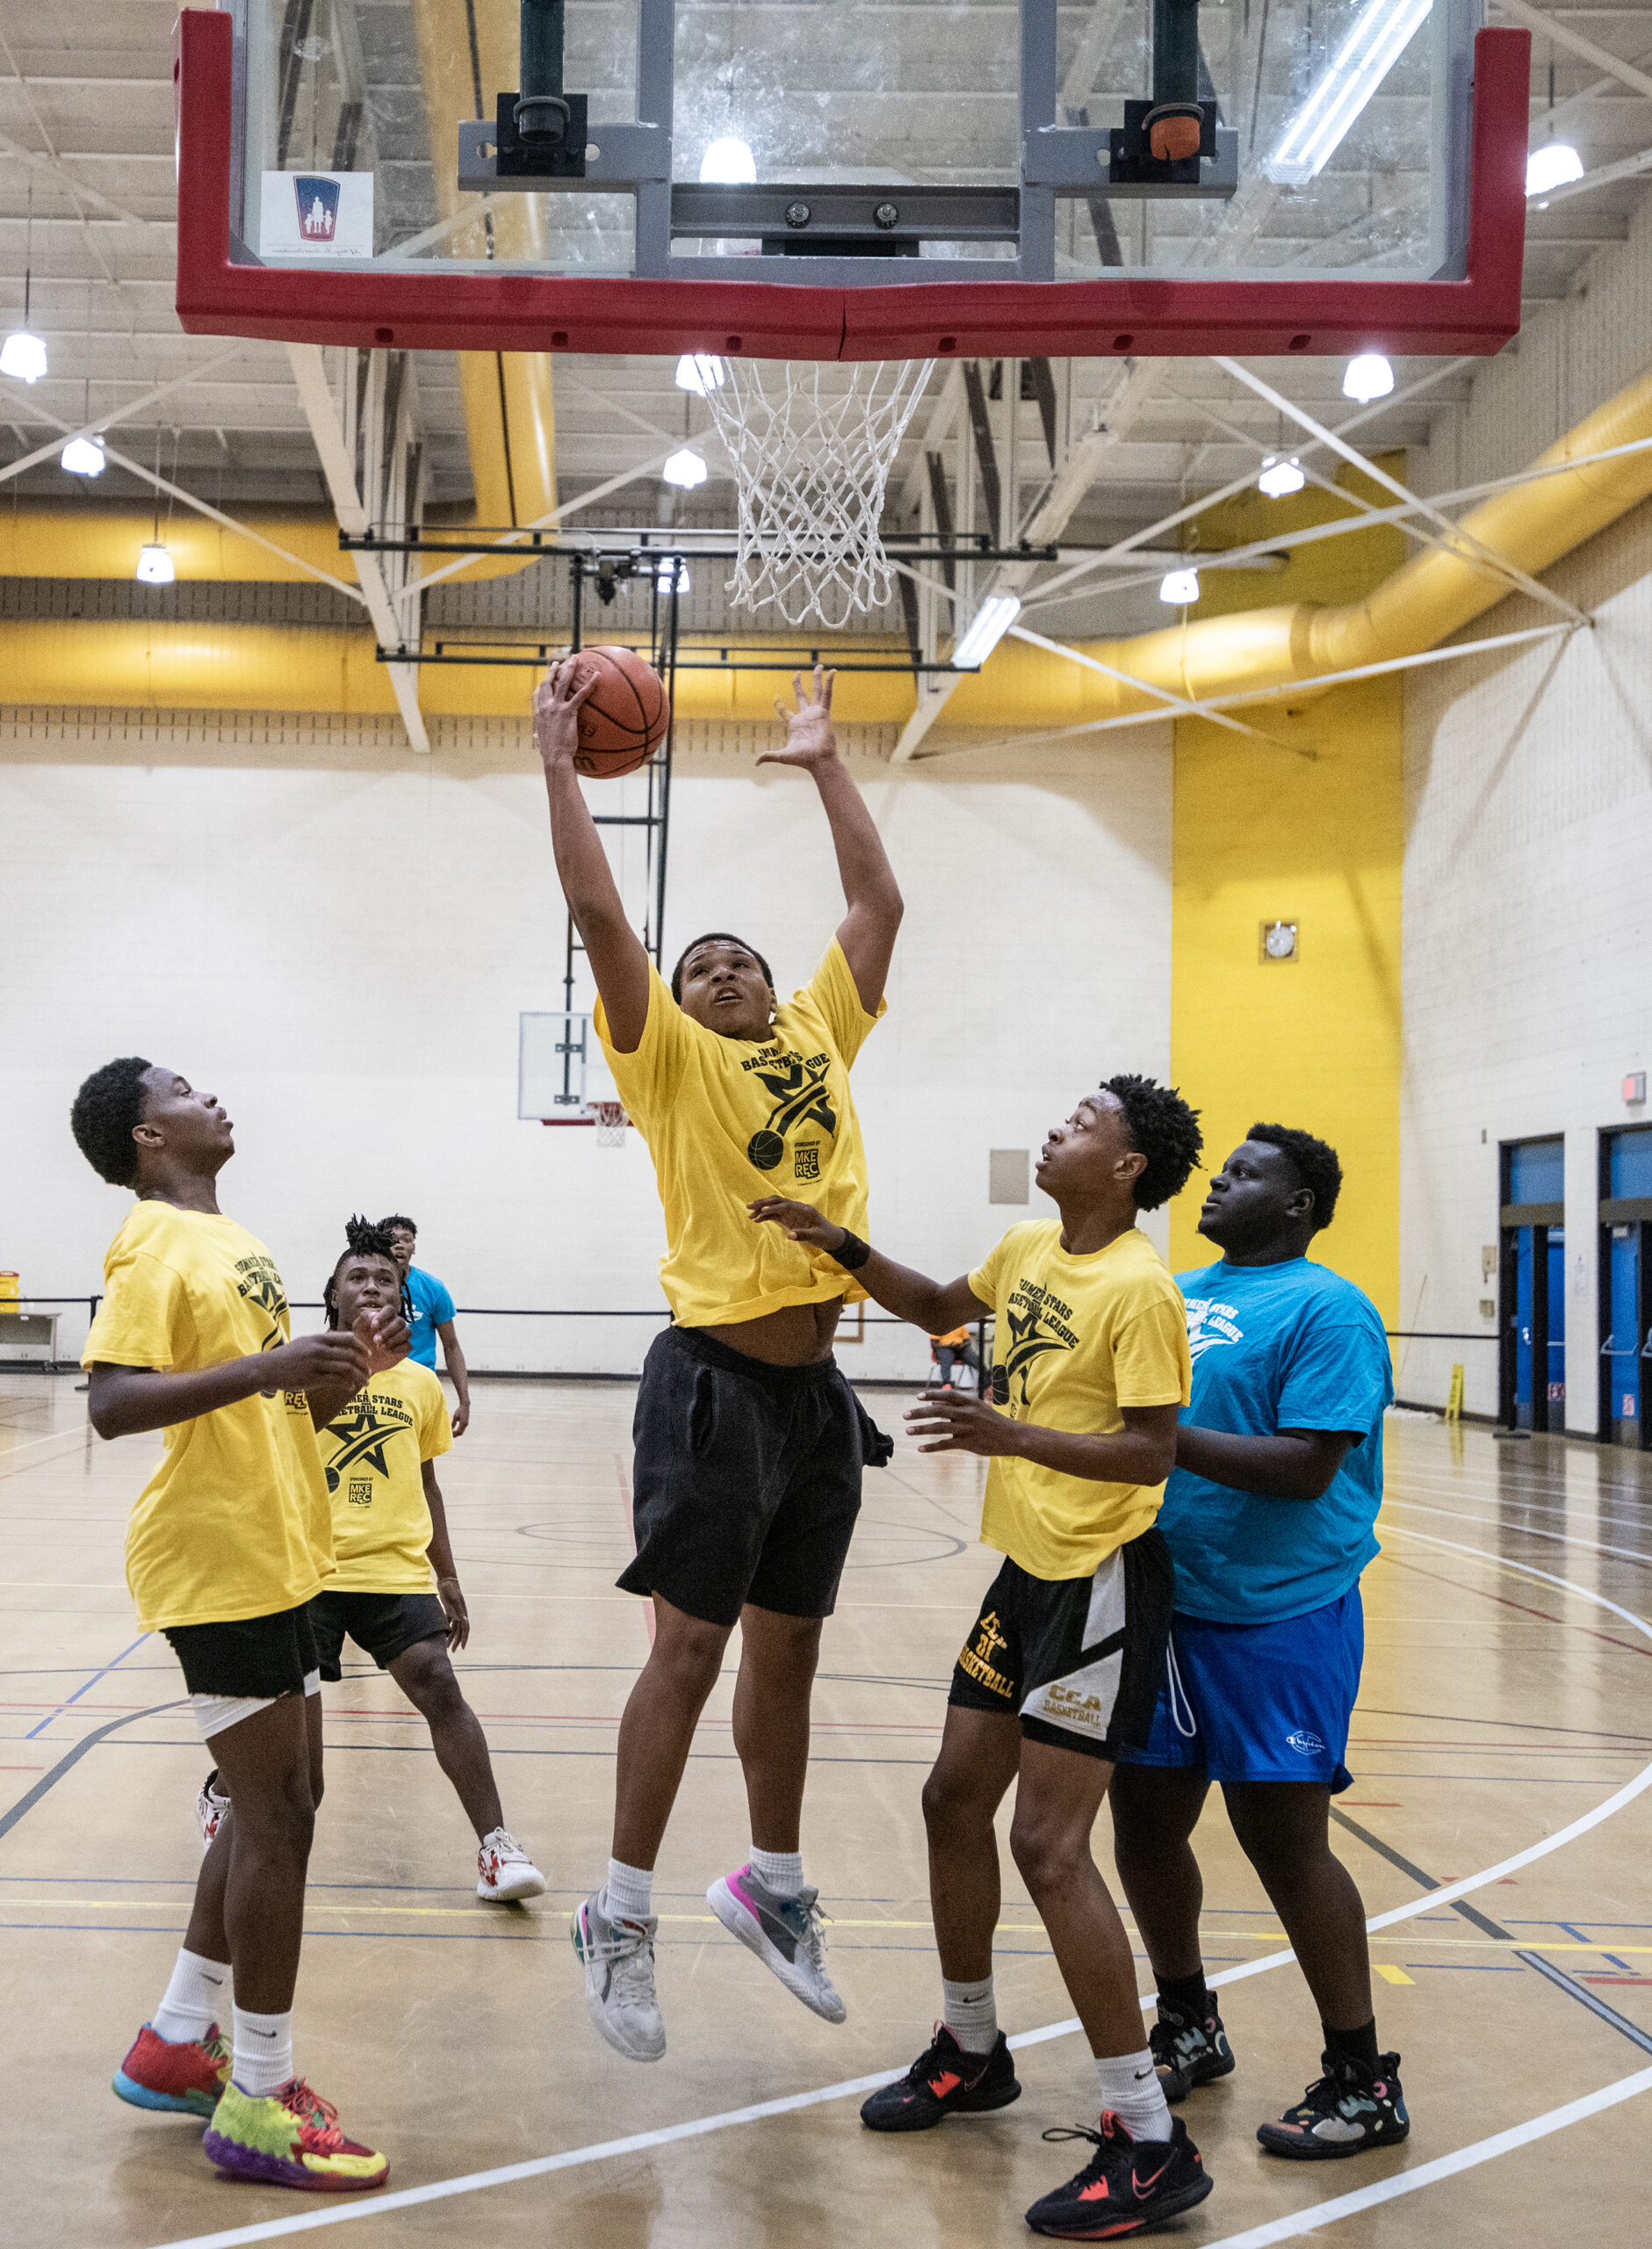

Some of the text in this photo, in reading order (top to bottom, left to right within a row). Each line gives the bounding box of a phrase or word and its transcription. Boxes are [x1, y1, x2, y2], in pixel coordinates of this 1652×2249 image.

[796, 1151, 817, 1163] MKE
[796, 1162, 819, 1176] REC
[1043, 1293, 1073, 1320] STARS
[1042, 1311, 1080, 1349] LEAGUE
[1208, 1315, 1244, 1343] LEAGUE
[372, 1394, 403, 1409] STARS
[381, 1407, 414, 1427] LEAGUE
[350, 1485, 371, 1493] MKE
[350, 1493, 371, 1502] REC
[1050, 1684, 1101, 1711] CCA
[1042, 1698, 1100, 1727] BASKETBALL
